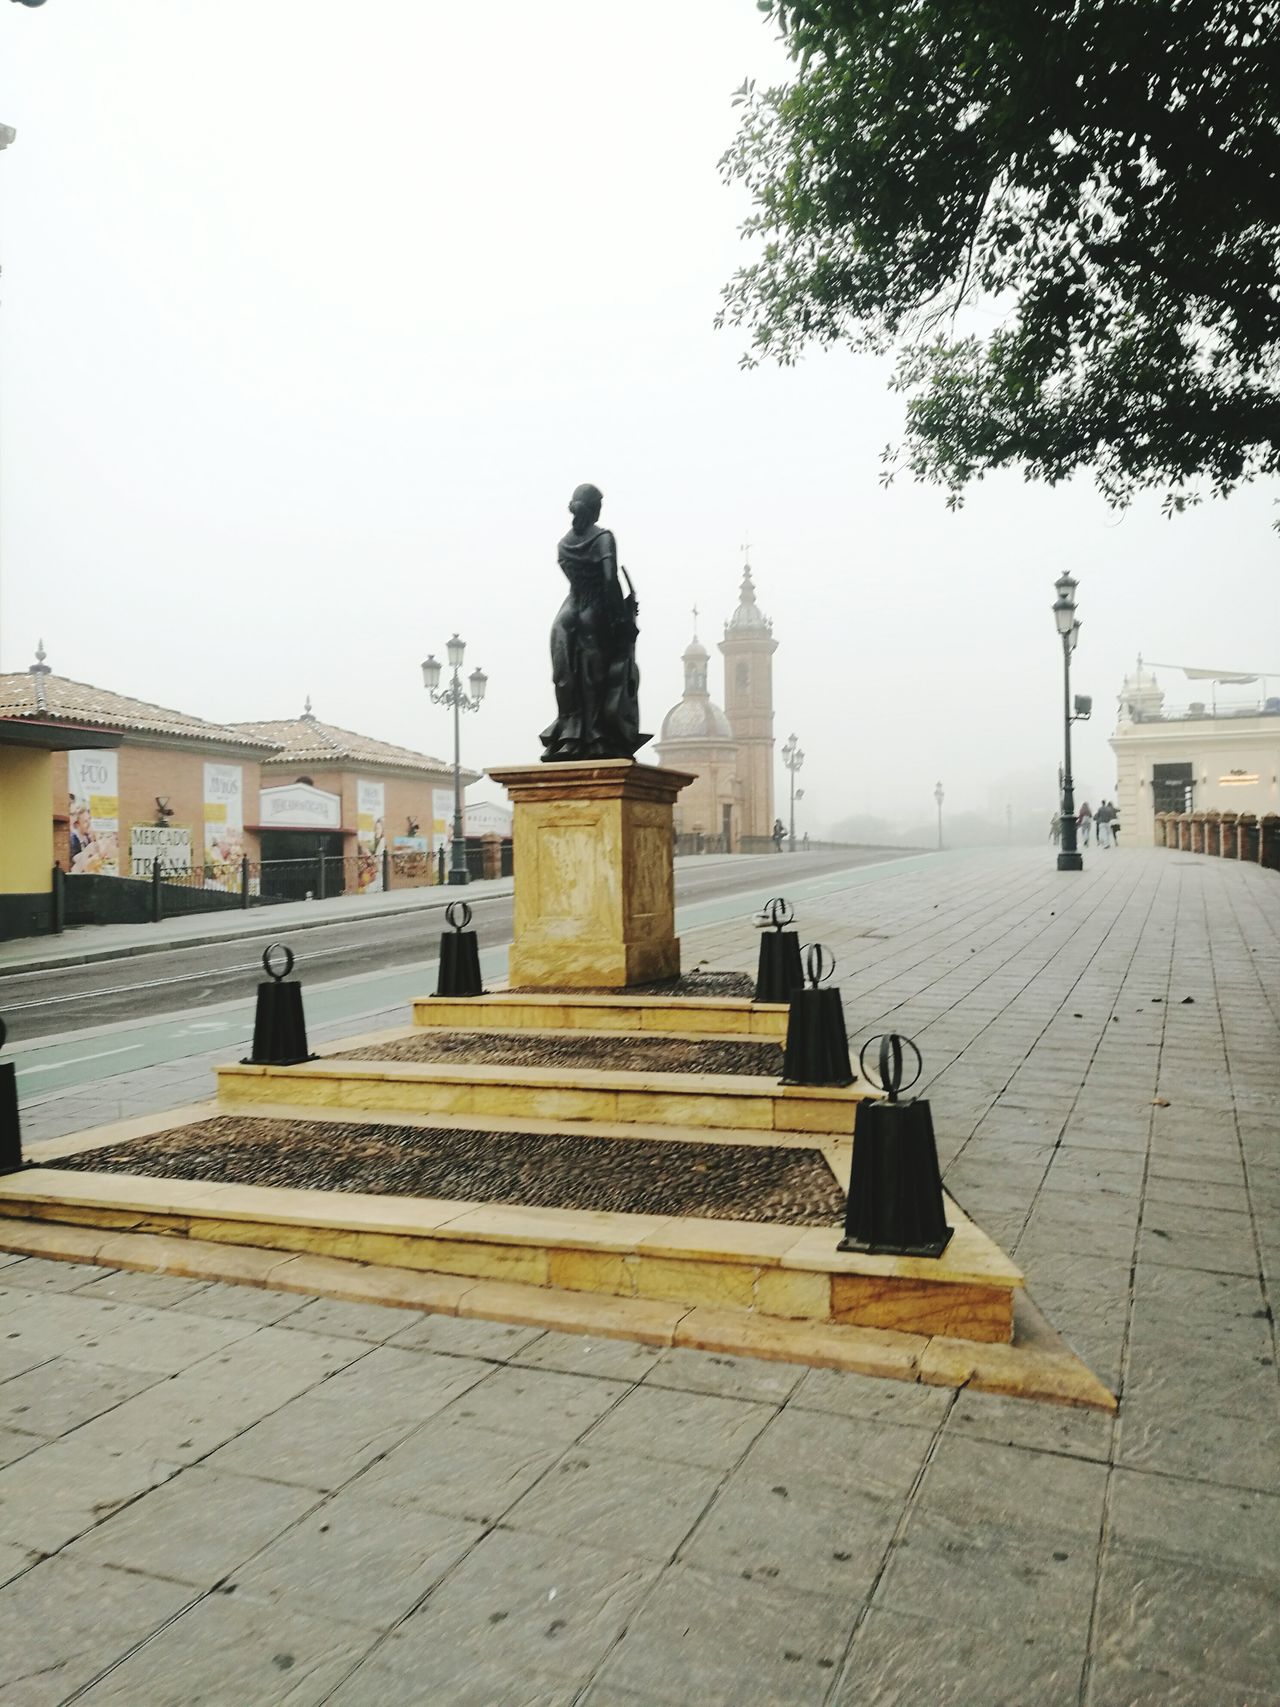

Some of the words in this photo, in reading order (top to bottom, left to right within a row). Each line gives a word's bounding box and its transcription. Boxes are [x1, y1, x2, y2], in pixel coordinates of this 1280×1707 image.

[132, 829, 189, 846] MERCADO
[156, 846, 168, 857] DE
[133, 858, 188, 875] TRANA
